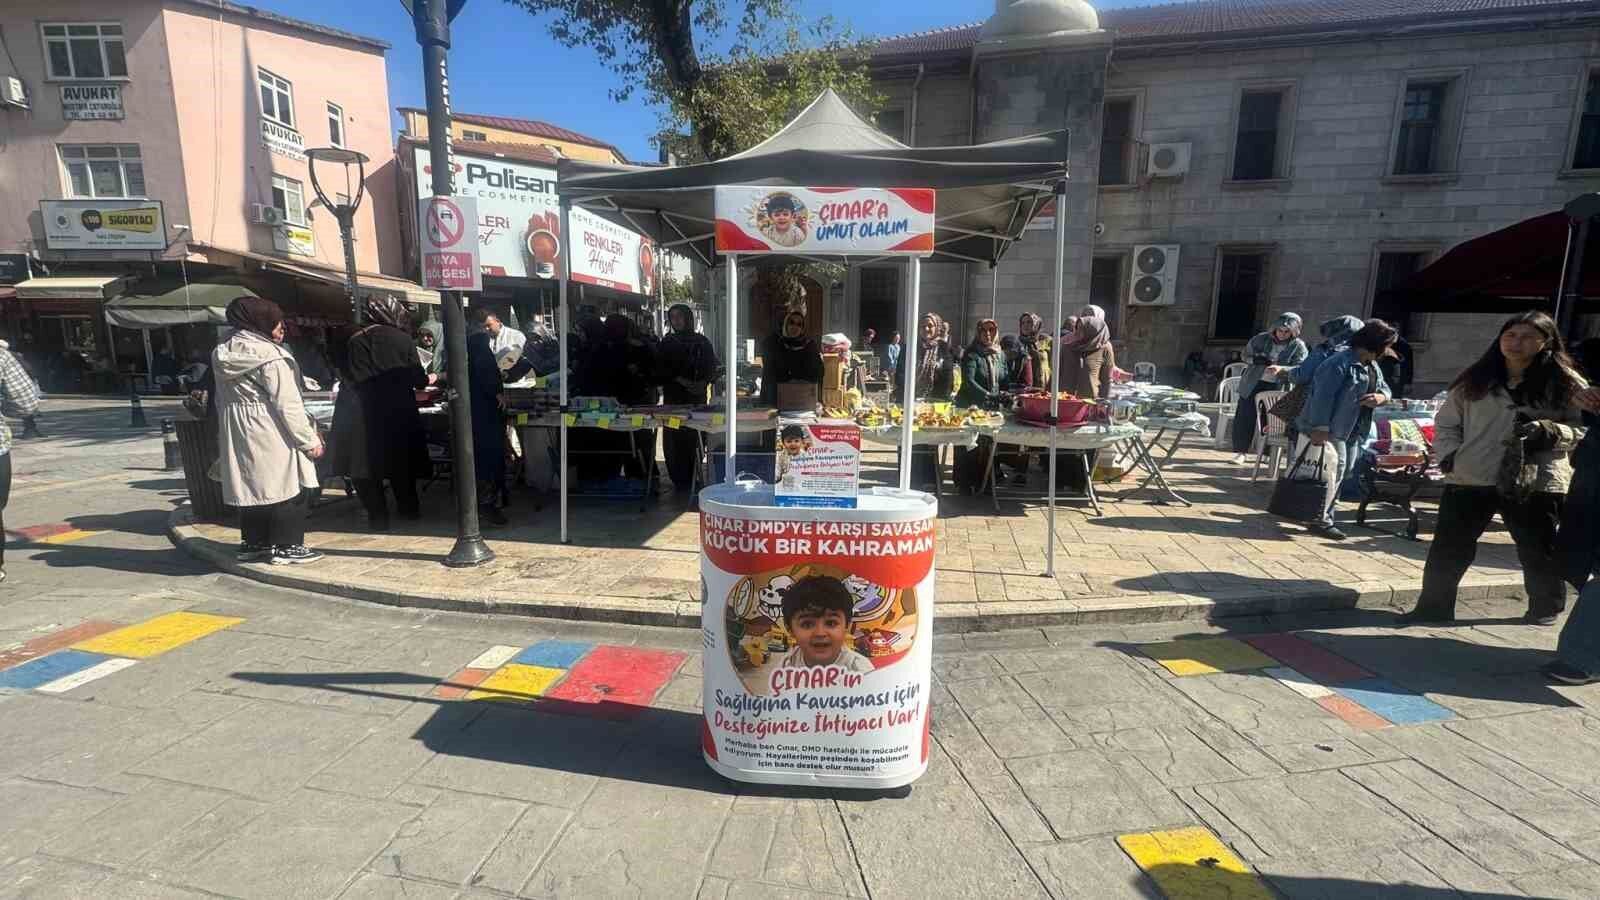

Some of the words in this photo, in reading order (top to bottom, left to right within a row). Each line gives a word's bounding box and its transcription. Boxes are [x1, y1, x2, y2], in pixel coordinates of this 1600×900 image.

[63, 87, 117, 100] AVUKAT
[263, 122, 304, 145] AVUKAT
[467, 163, 558, 195] Polisan
[819, 199, 889, 225] ÇINAR'A
[859, 218, 908, 238] OLALIM
[431, 255, 458, 265] YAYA
[748, 520, 812, 536] DMD'YE
[816, 521, 867, 538] KARŞI
[705, 529, 769, 554] KÜÇÜK
[818, 535, 933, 556] KAHRAMAN
[715, 689, 791, 717] Sağlığına
[796, 691, 890, 711] Kavuşması
[894, 682, 921, 707] için
[714, 710, 810, 740] Desteğinize
[814, 711, 883, 737] İhtiyacı
[887, 701, 920, 727] Var!
[759, 743, 775, 751] ben
[766, 752, 818, 761] Hayallerimin
[820, 755, 859, 763] peşinden
[796, 761, 824, 769] destek
